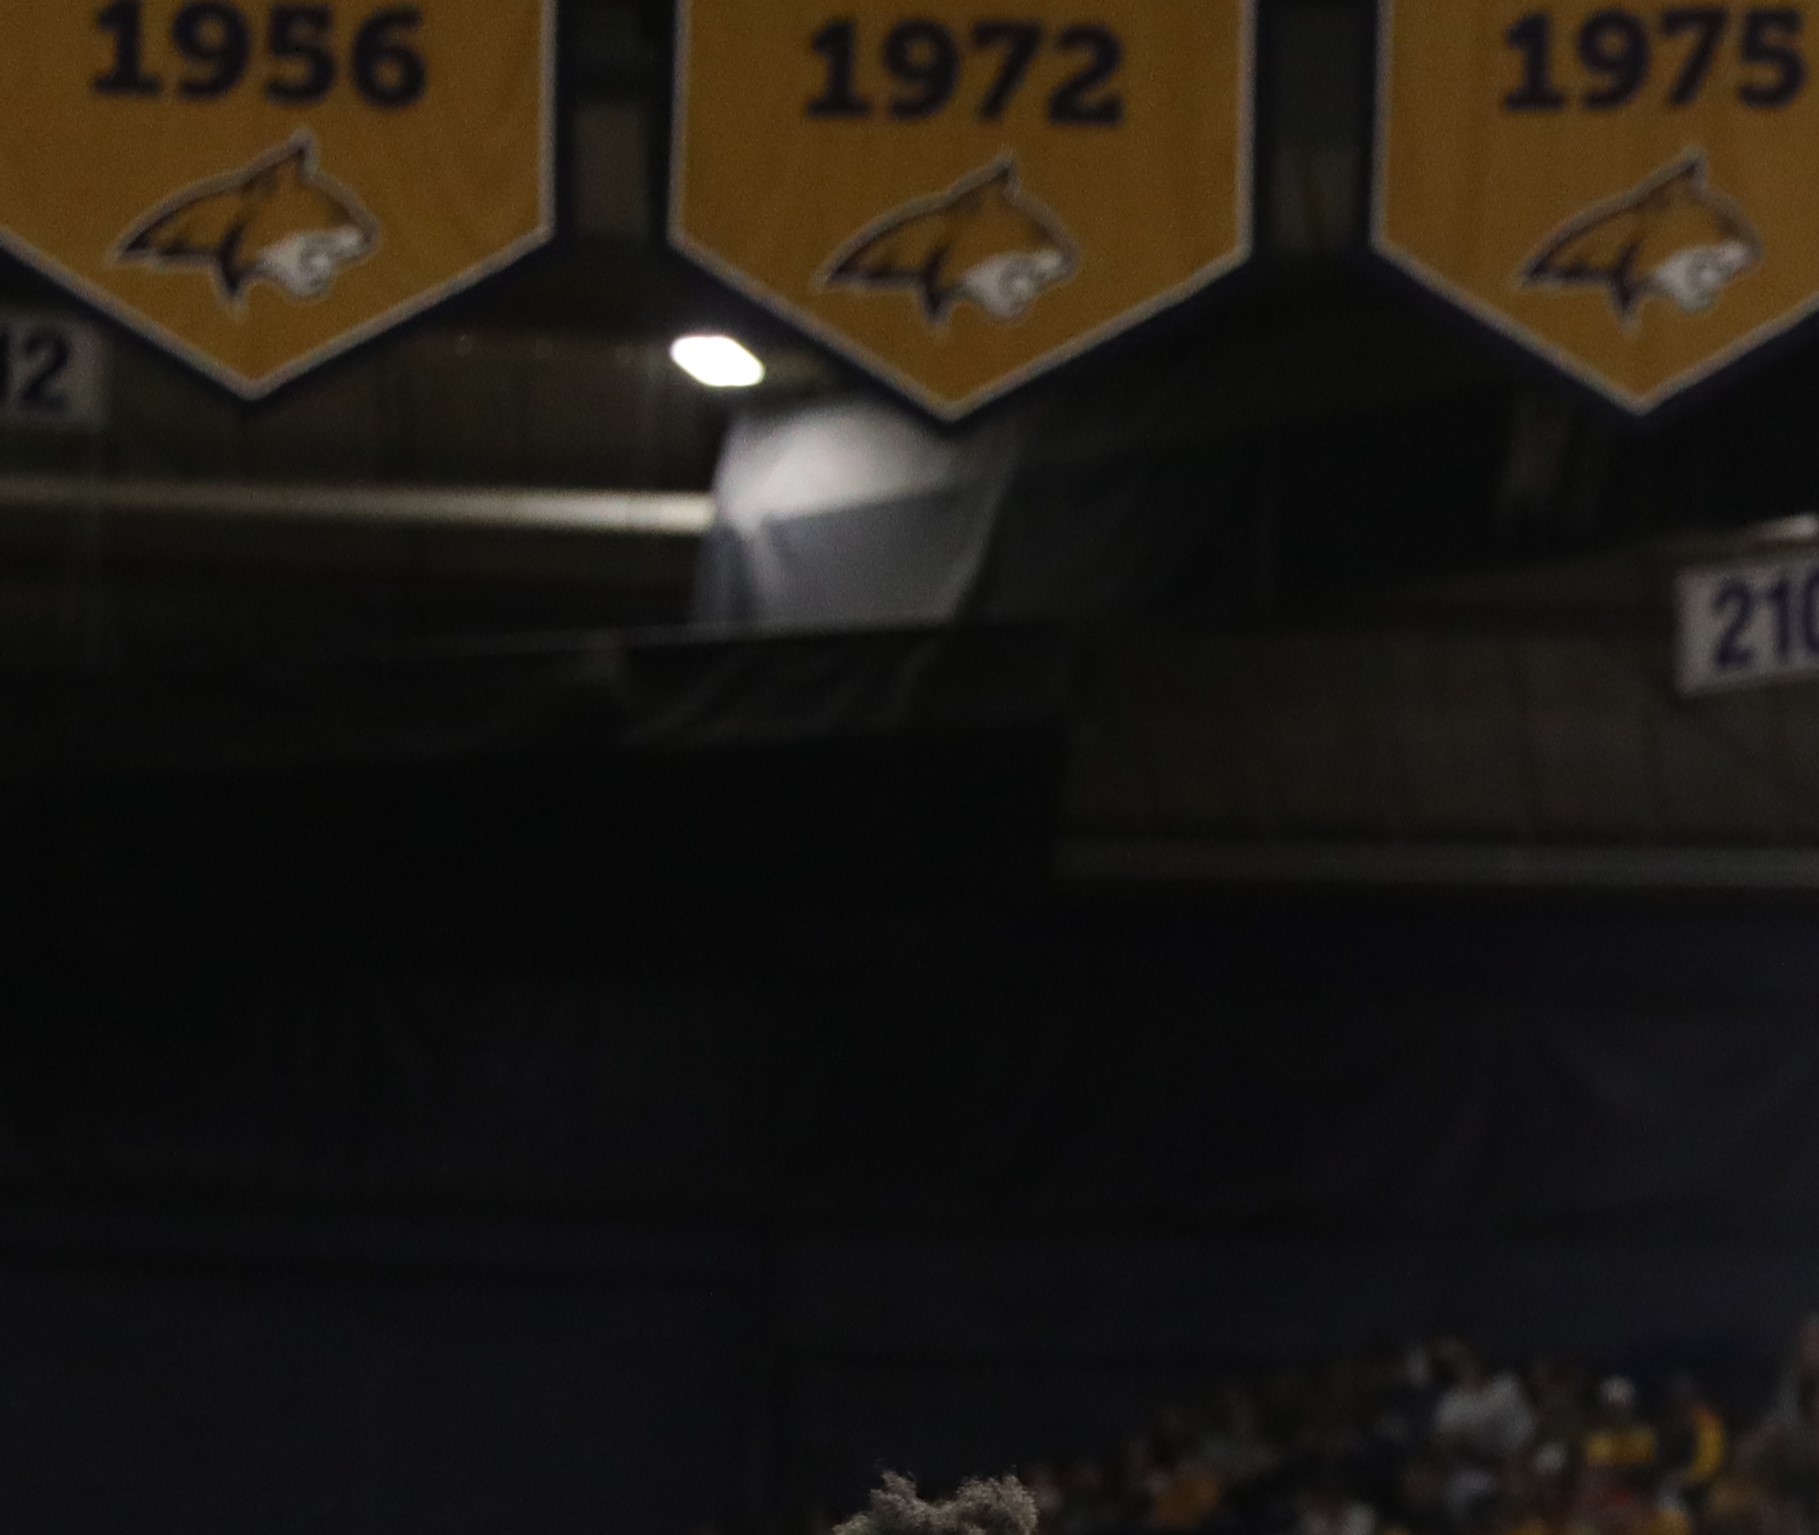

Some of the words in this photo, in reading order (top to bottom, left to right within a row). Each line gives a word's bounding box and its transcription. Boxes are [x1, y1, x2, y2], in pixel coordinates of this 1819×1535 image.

[91, 0, 428, 108] 1956
[804, 18, 1126, 126] 1972
[1502, 5, 1811, 112] 1975
